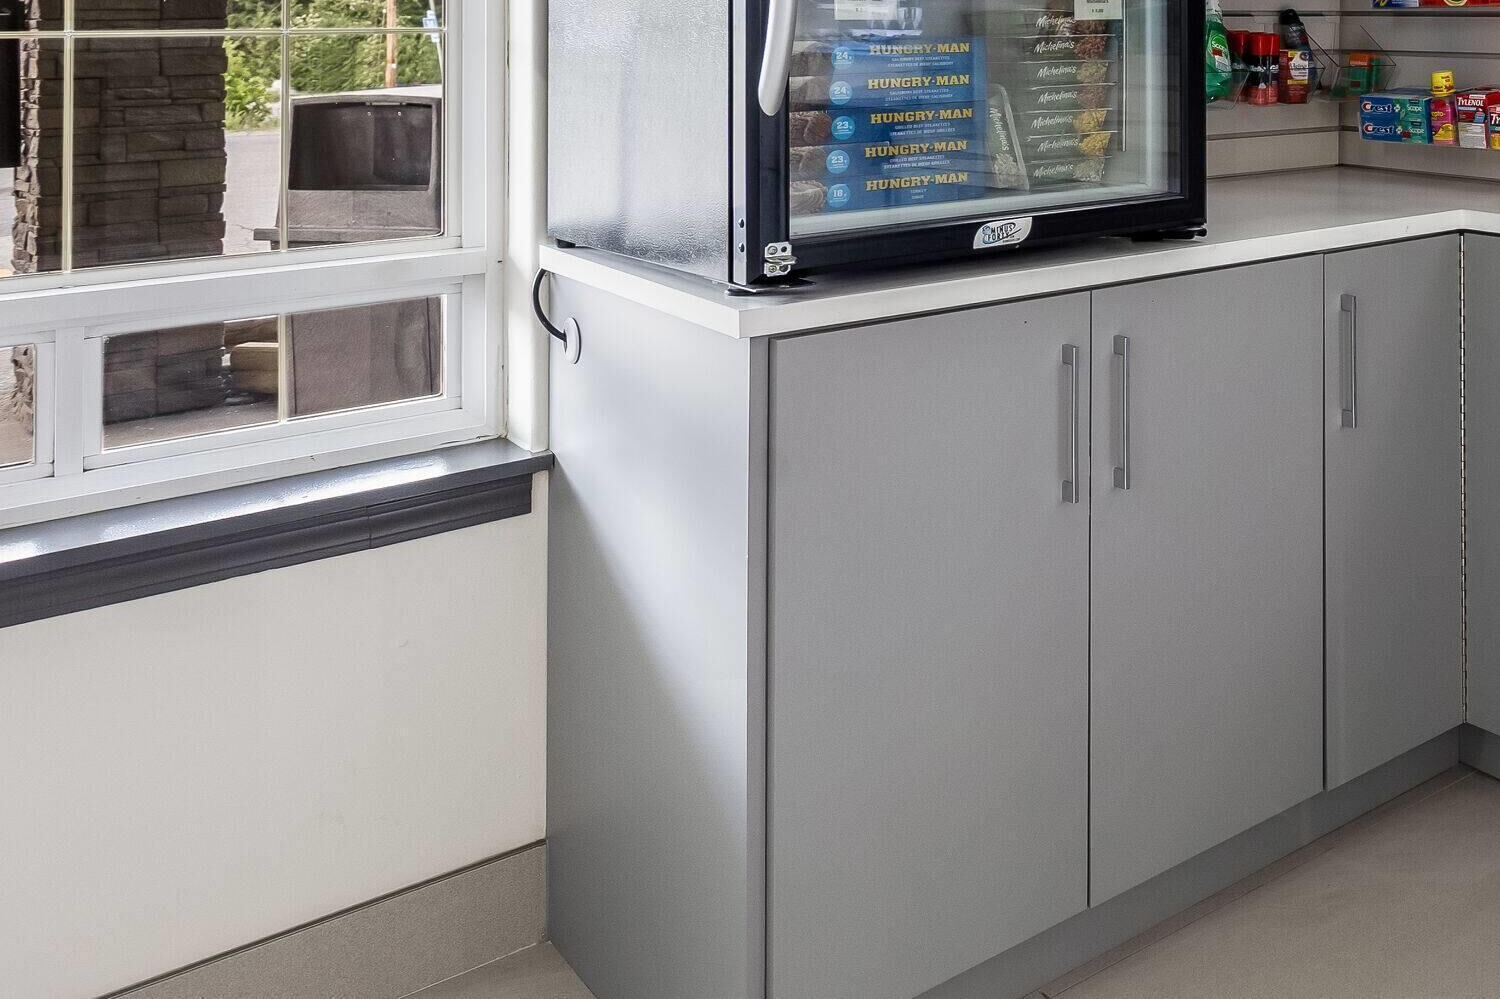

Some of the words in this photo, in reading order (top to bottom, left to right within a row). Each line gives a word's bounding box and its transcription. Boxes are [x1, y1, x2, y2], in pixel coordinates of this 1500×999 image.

[869, 42, 970, 56] HUNGRY-MAN
[1034, 40, 1075, 53] Michelina's
[836, 52, 848, 60] 24
[1037, 65, 1077, 78] Michelina's
[868, 75, 970, 89] HUNGRY-MAN
[834, 86, 847, 94] 24
[1362, 102, 1392, 113] Crest
[1407, 104, 1422, 112] Scope
[1457, 97, 1485, 107] TYLENOL
[870, 108, 973, 124] HUNGRY-MAN
[1031, 116, 1073, 129] Michelina's
[837, 121, 849, 129] 23
[1363, 123, 1394, 134] Crest
[864, 140, 968, 158] HUNGRY-MAN
[1034, 164, 1075, 178] Michelina's
[866, 172, 968, 191] HUNGRY-MAN
[991, 224, 1013, 234] MINUS
